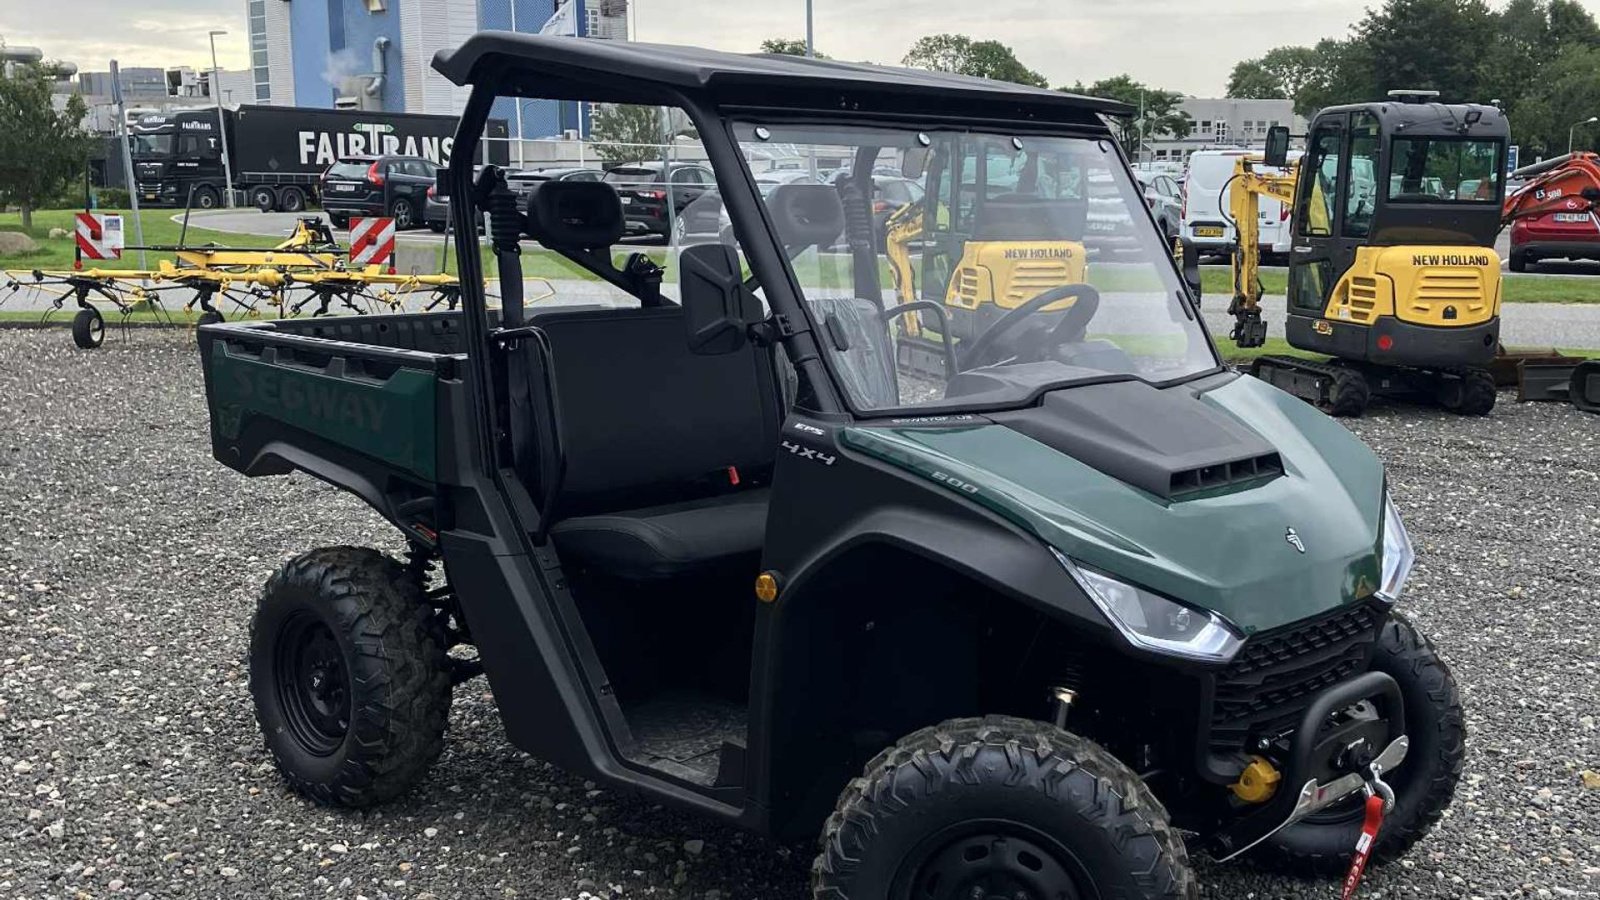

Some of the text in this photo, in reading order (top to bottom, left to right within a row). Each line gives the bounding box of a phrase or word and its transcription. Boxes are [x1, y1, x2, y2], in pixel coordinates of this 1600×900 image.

[299, 123, 455, 169] FAIRTRANS
[1004, 247, 1073, 259] NEW HOLLAND
[1412, 255, 1489, 266] NEW HOLLAND
[232, 367, 389, 434] SEGWAY
[794, 422, 825, 436] EPS
